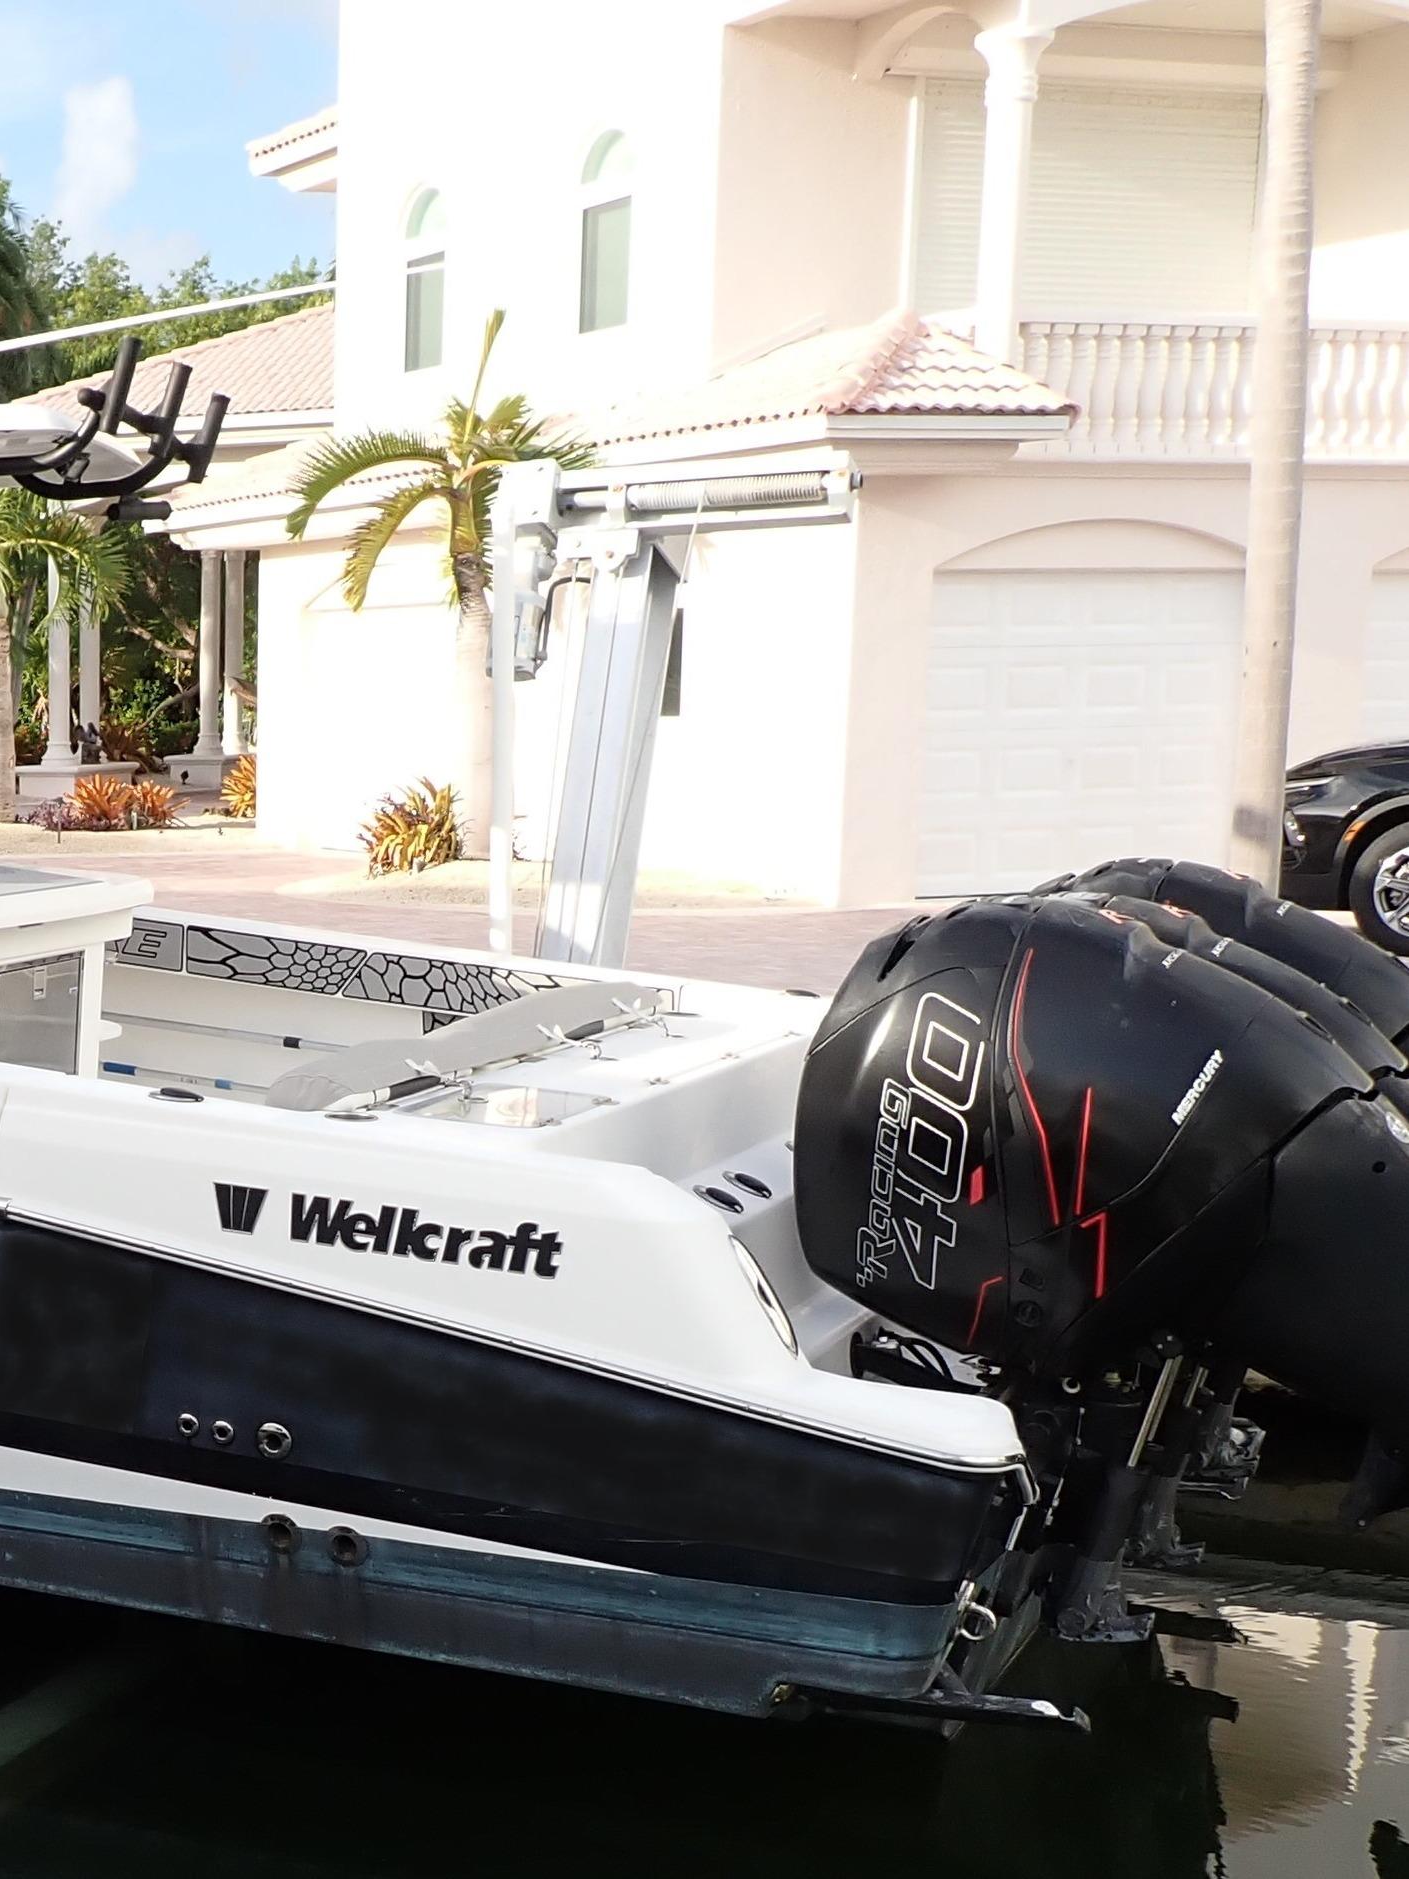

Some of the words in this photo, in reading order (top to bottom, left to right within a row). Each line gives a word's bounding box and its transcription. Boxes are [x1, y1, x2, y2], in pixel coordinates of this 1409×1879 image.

[892, 992, 986, 1290] 400
[1171, 1048, 1223, 1126] MERCURY
[291, 1192, 564, 1279] Wellcraft
[856, 1077, 911, 1282] Racing
